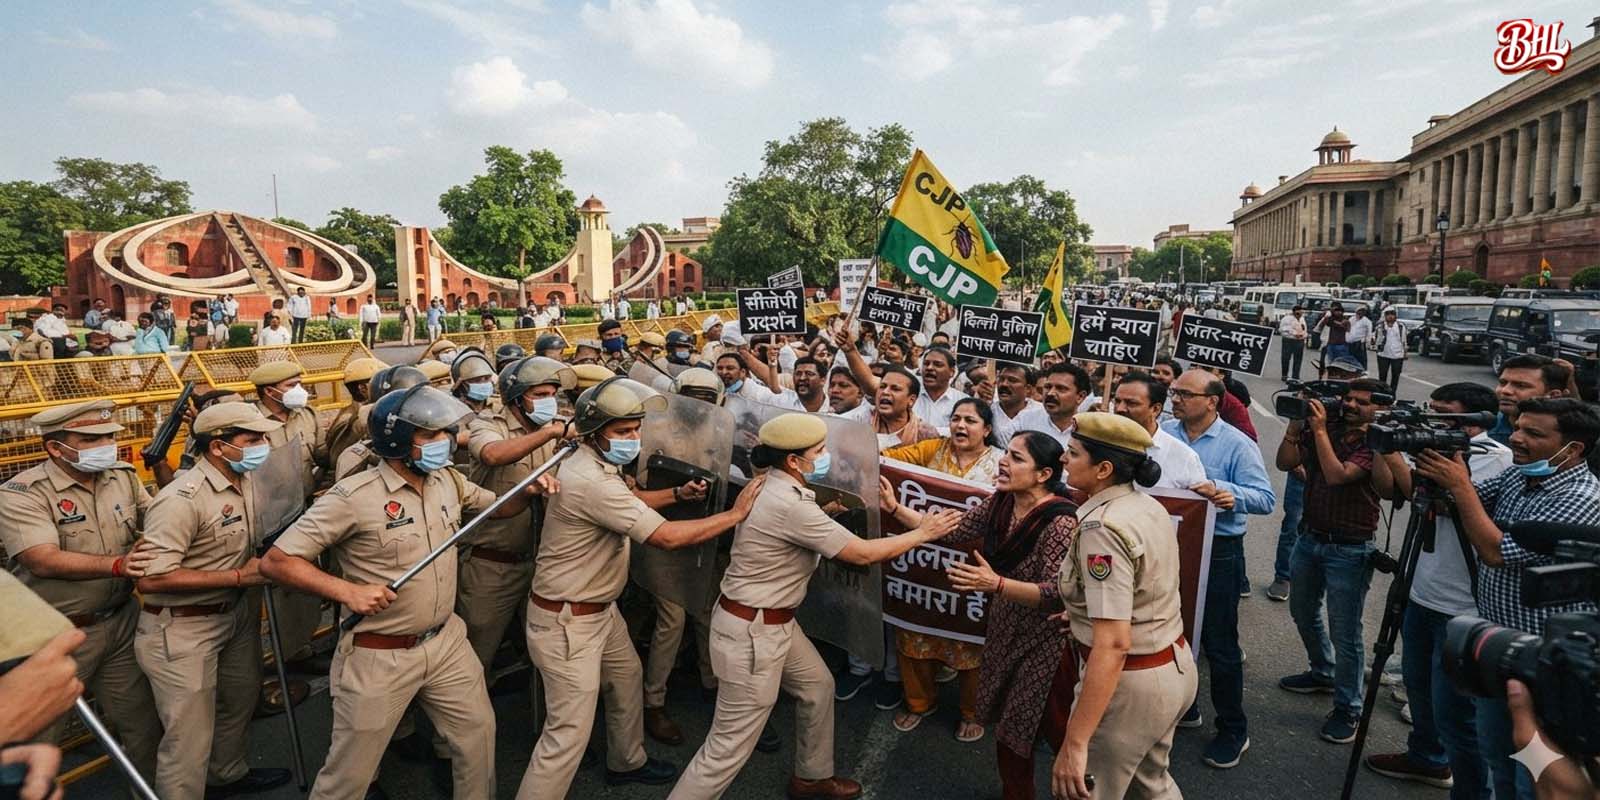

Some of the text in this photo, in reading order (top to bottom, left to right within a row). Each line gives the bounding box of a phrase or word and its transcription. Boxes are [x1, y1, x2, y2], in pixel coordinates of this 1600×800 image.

[915, 172, 965, 213] CJP
[908, 245, 978, 299] CJP
[1079, 309, 1157, 336] हमें न्याय
